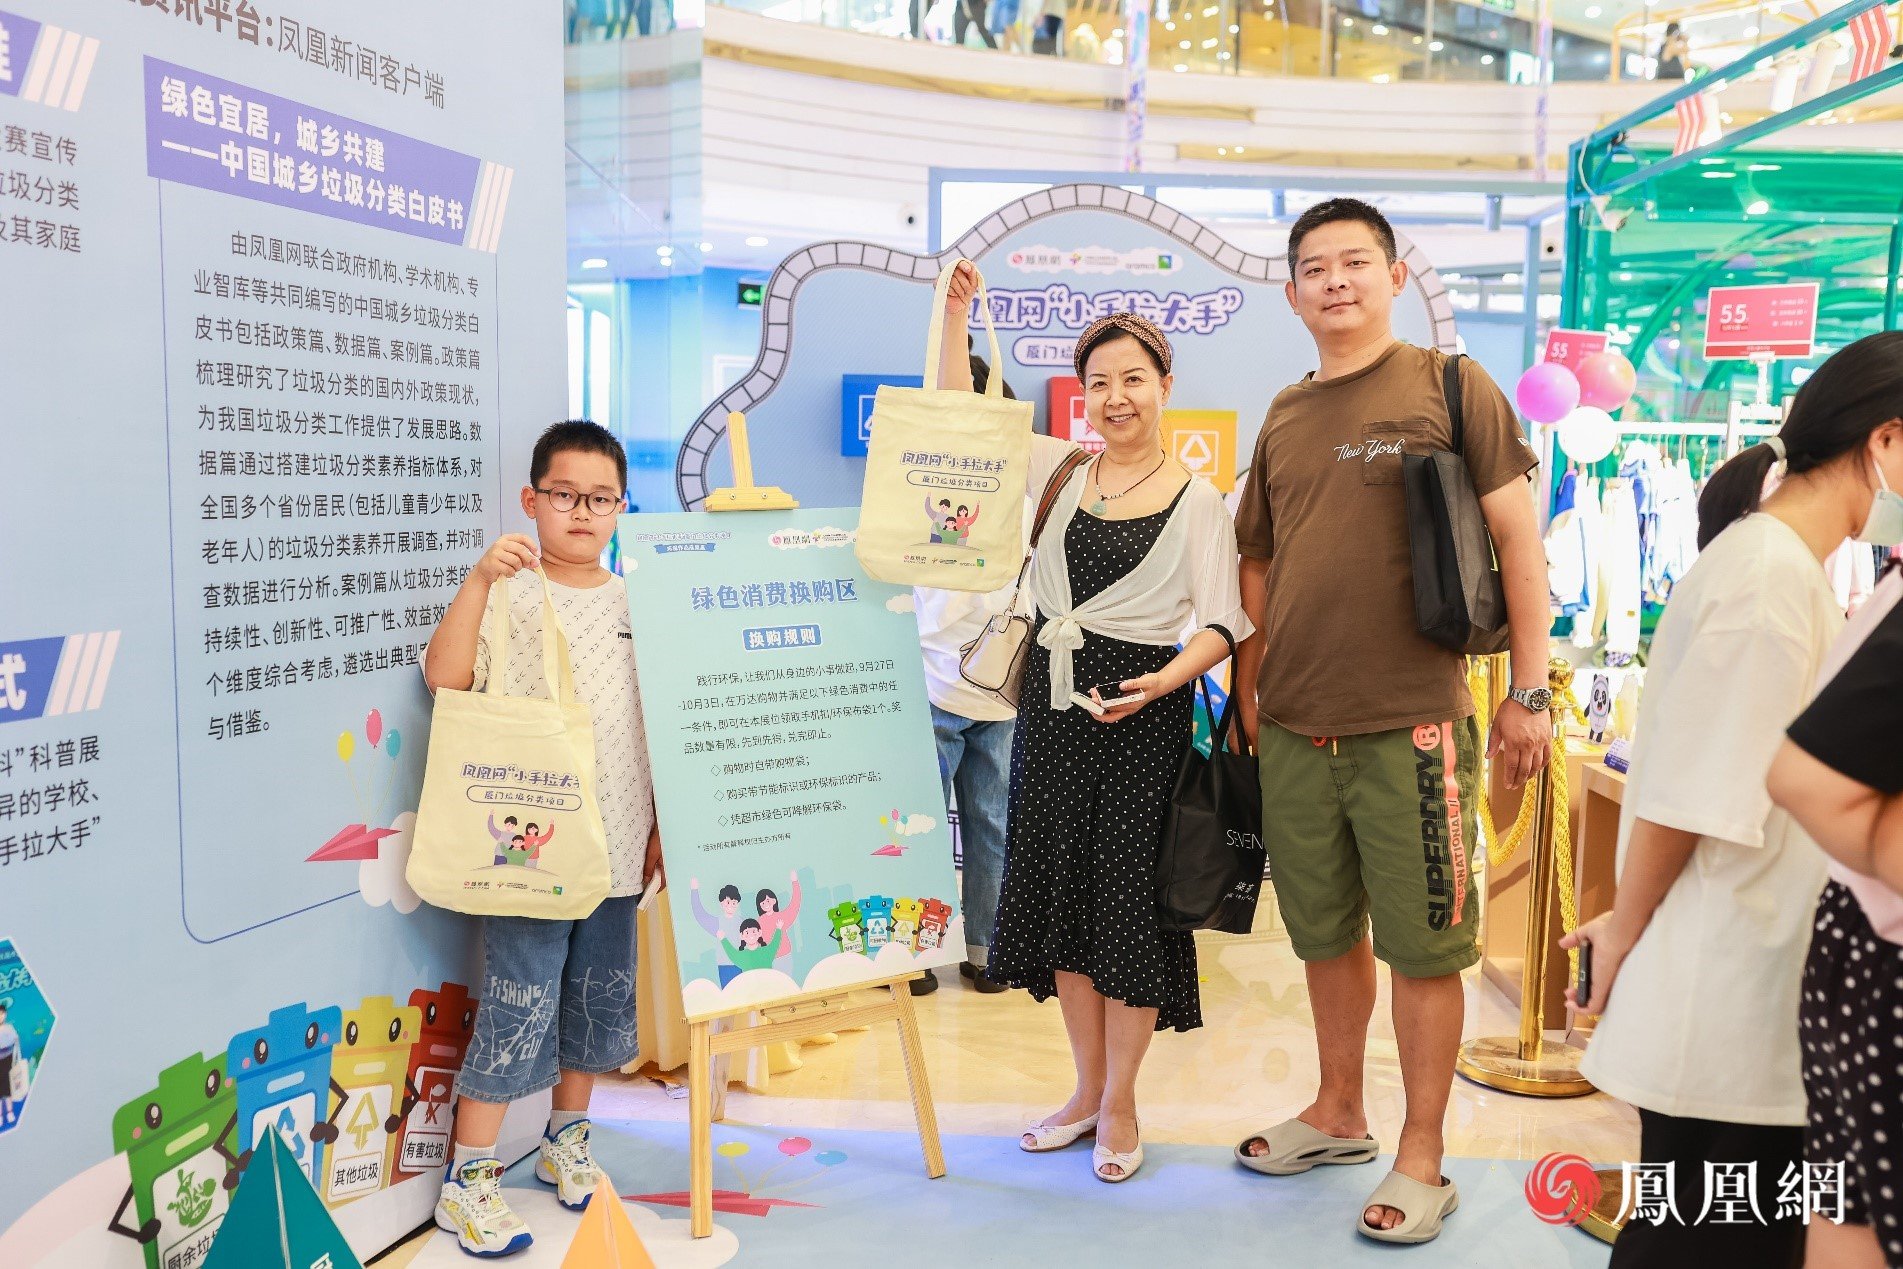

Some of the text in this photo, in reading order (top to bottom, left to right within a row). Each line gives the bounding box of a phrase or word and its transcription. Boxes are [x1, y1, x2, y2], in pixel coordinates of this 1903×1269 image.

[160, 75, 385, 173] 绿色宜居，城乡共建
[0, 170, 79, 210] 圾分类
[231, 230, 479, 298] 由凤凰网联合政府机构、学术机构、专
[194, 268, 479, 334] 业智库等共同编写的中国城乡垃圾分类白
[195, 314, 480, 371] 皮书包括政策篇、数据篇、案例篇。政策篇
[196, 358, 479, 407] 梳理研究了垃圾分类的国内外政策现状，
[198, 404, 482, 442] 为我国垃圾分类工作提供了发展思路。数
[199, 450, 483, 478] 据篇通过搭建垃圾分类素养指标体系，对
[1334, 438, 1405, 463] New York
[203, 563, 477, 609] 查数据进行分析。案例篇从垃圾分类的
[691, 577, 858, 611] 绿色消费换购区
[204, 602, 452, 654] 持续性、创新性、可推广性、效益效
[749, 627, 816, 649] 换购规则
[207, 709, 270, 741] 与借鉴。
[1414, 747, 1453, 932] SUPERDRY
[406, 1141, 444, 1159] 有害垃圾
[334, 1162, 378, 1187] 其他垃圾
